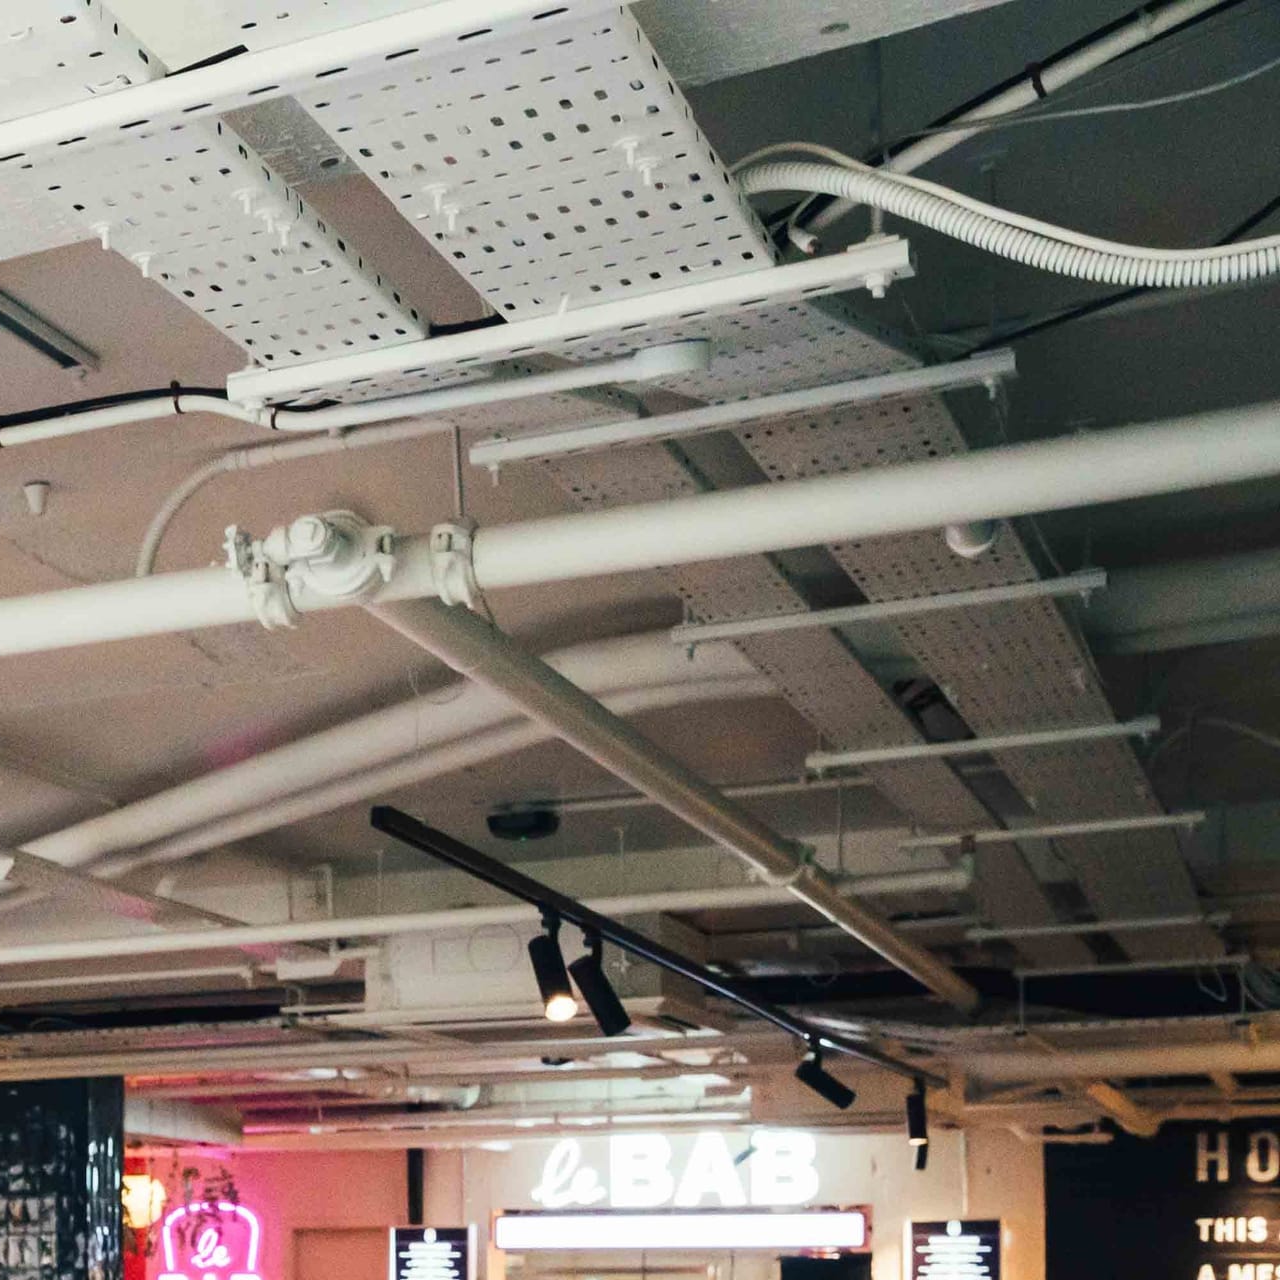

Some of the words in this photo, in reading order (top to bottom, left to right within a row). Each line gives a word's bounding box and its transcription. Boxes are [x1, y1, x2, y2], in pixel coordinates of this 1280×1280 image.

[531, 1138, 607, 1208] le
[610, 1129, 820, 1207] BAB
[191, 1228, 231, 1269] le
[1195, 1216, 1269, 1243] THIS
